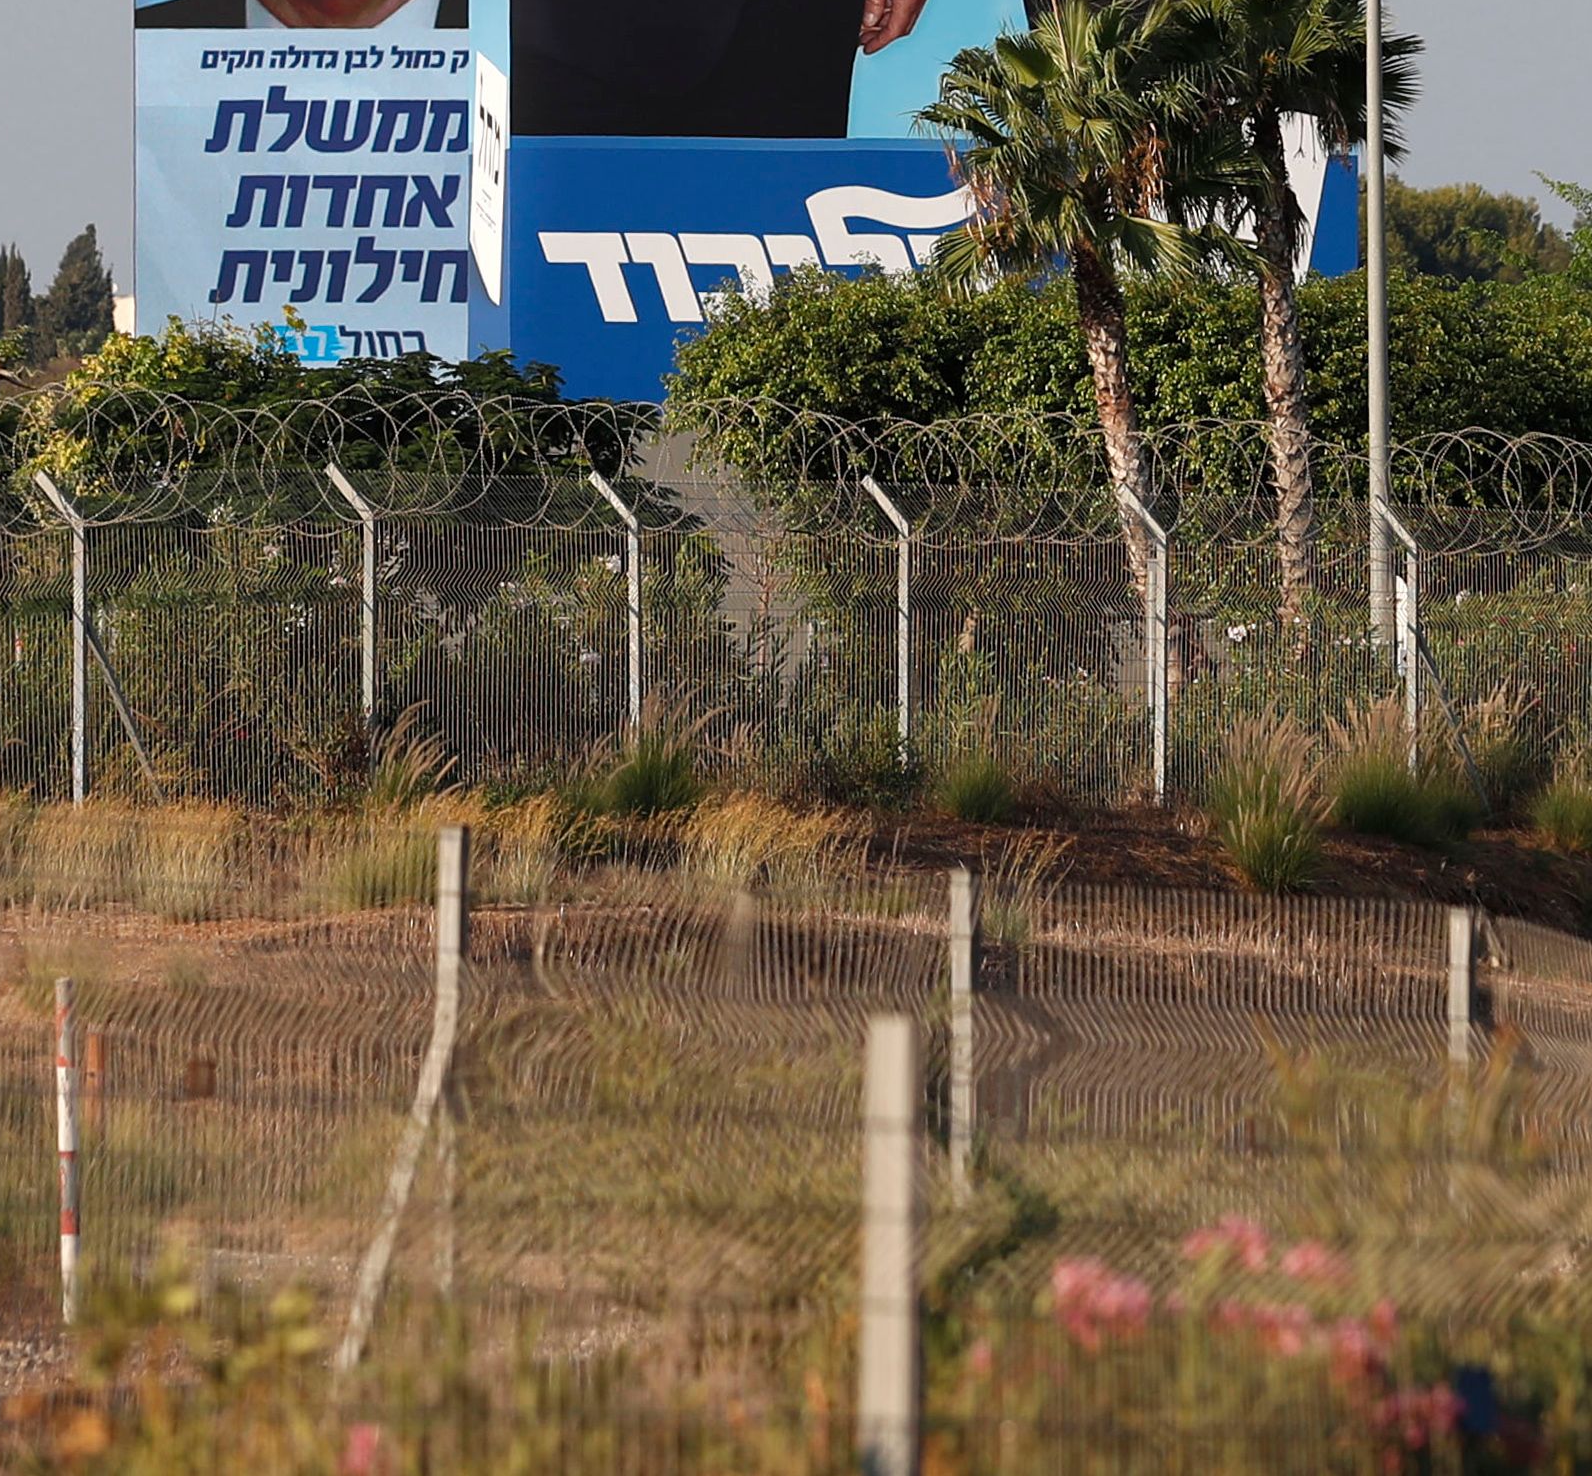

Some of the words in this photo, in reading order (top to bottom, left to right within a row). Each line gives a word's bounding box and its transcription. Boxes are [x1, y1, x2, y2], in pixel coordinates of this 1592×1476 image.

[200, 49, 265, 75] תקים
[269, 44, 339, 70] גדולה
[343, 44, 385, 75] לבן
[390, 44, 446, 70] כחול
[203, 85, 470, 154] ממשלת
[225, 174, 462, 229] אחדות
[208, 235, 470, 305] חילונית
[538, 183, 1000, 323] ליכוד
